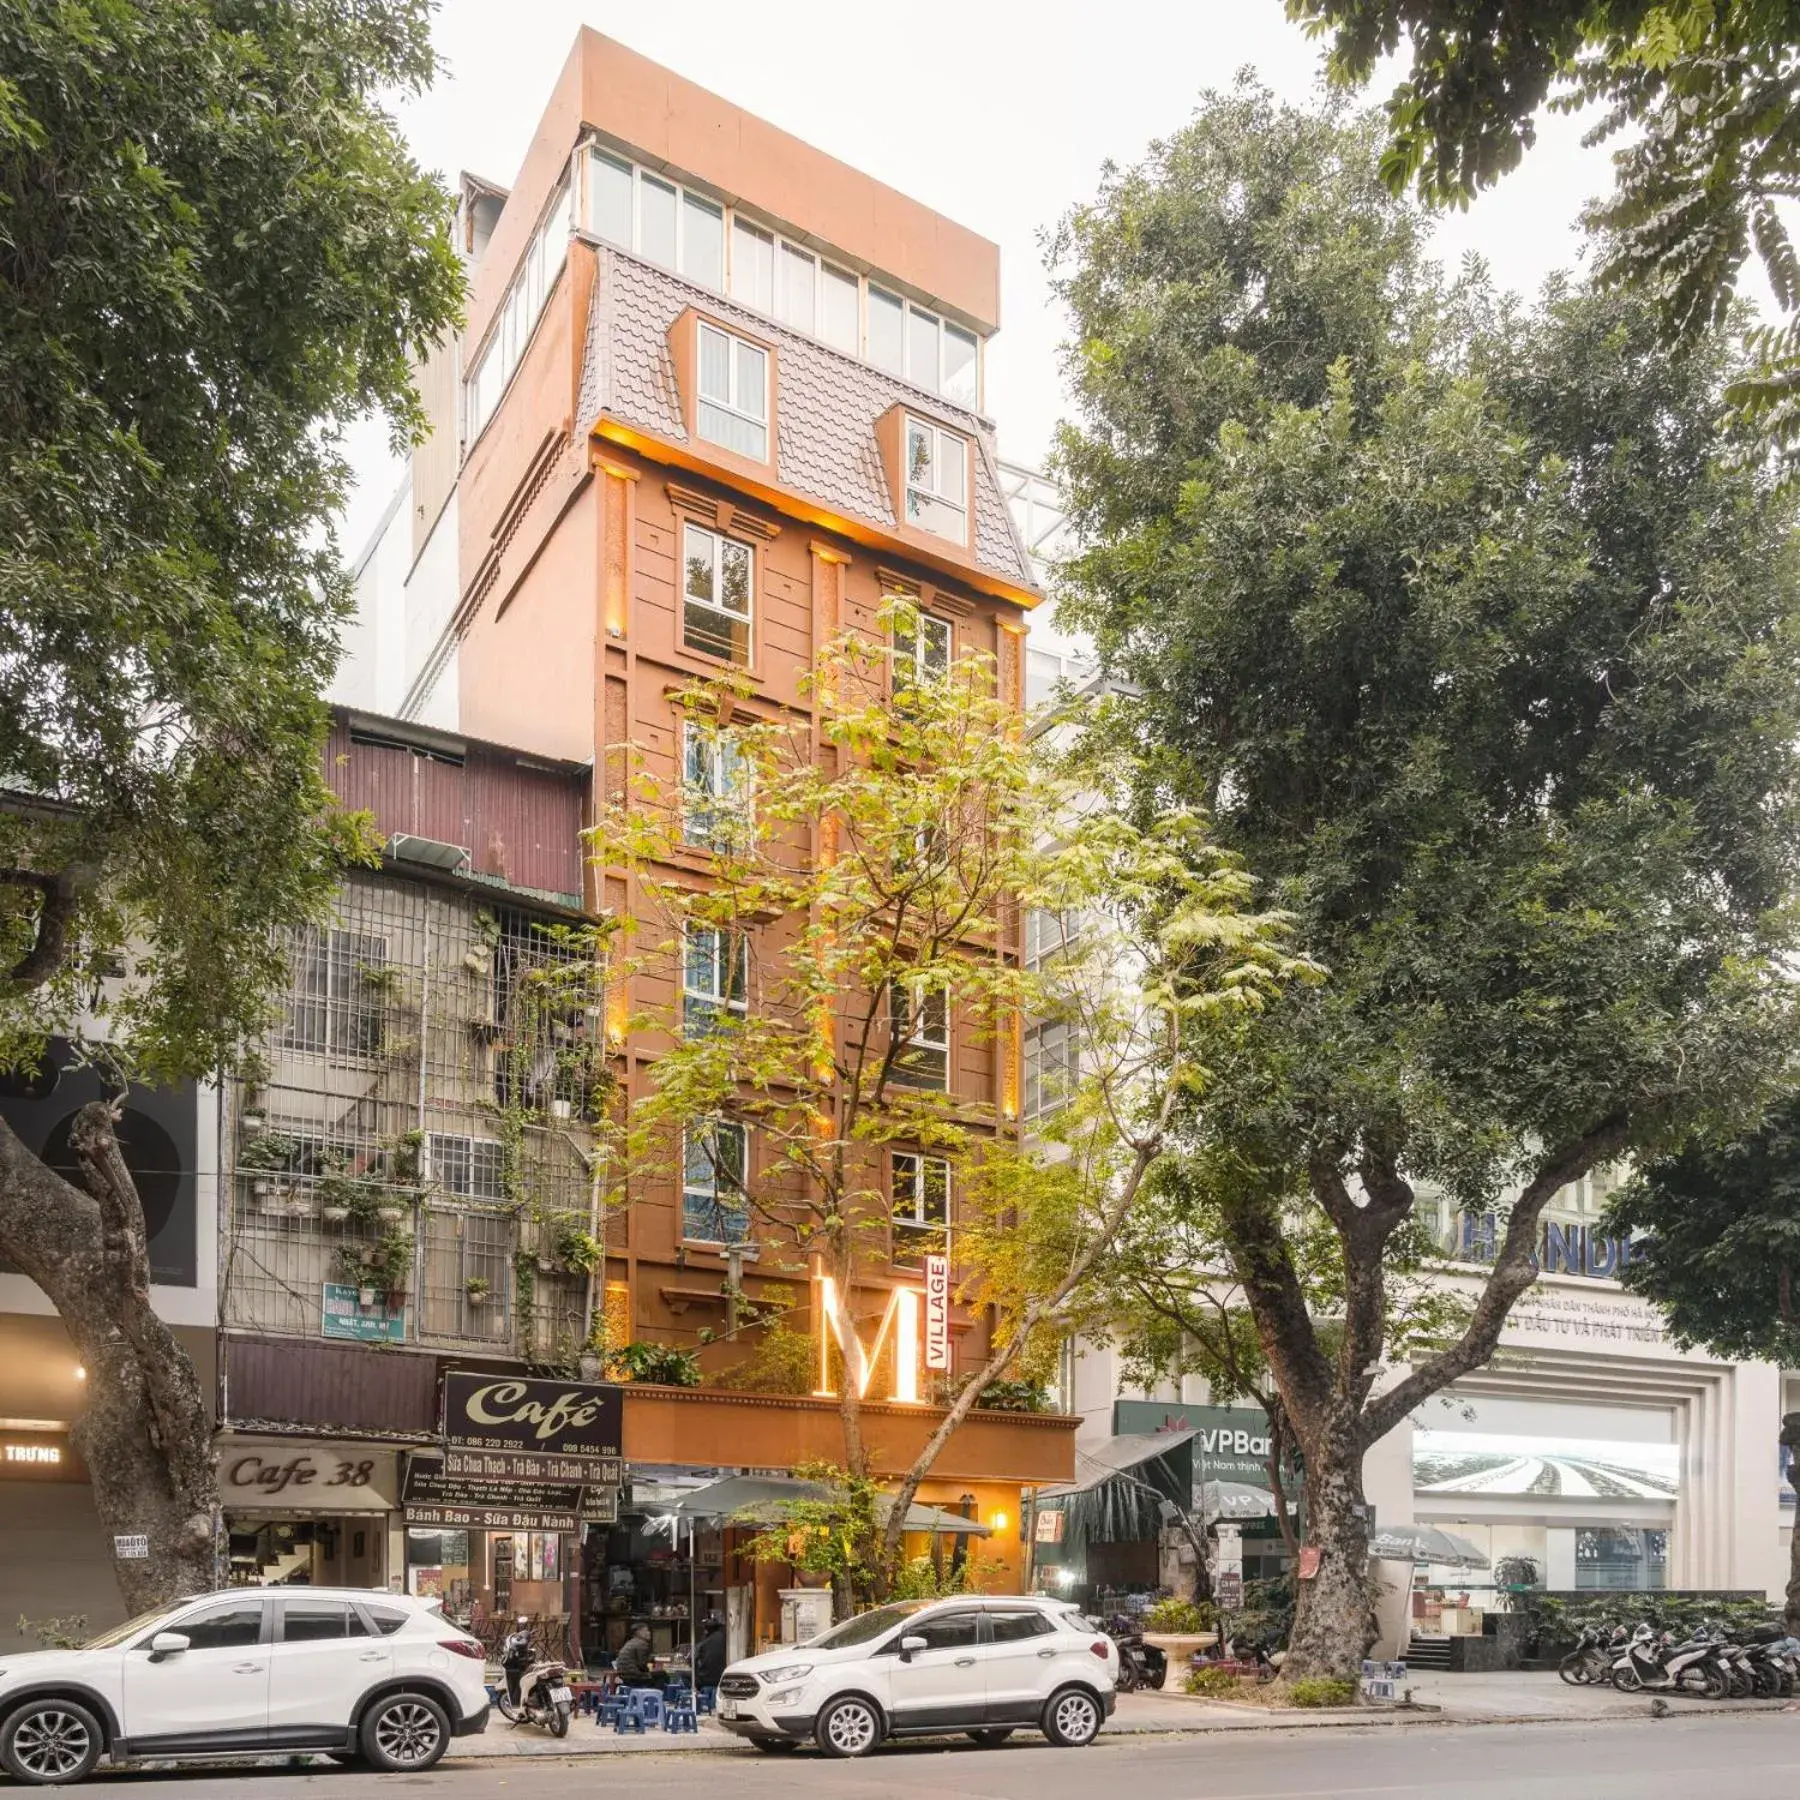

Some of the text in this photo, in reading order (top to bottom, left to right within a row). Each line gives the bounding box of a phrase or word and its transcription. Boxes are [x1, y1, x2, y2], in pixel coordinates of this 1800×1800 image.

[1463, 1212, 1646, 1279] HNDI
[930, 1263, 945, 1361] VILLAGE
[812, 1275, 927, 1404] M
[1201, 1429, 1273, 1455] VPBan
[229, 1456, 375, 1494] Cafe 38
[1213, 1460, 1235, 1470] Nam
[406, 1507, 440, 1521] Bánh
[445, 1510, 470, 1523] Bao
[484, 1511, 509, 1525] Sữa
[542, 1514, 574, 1529] Nành
